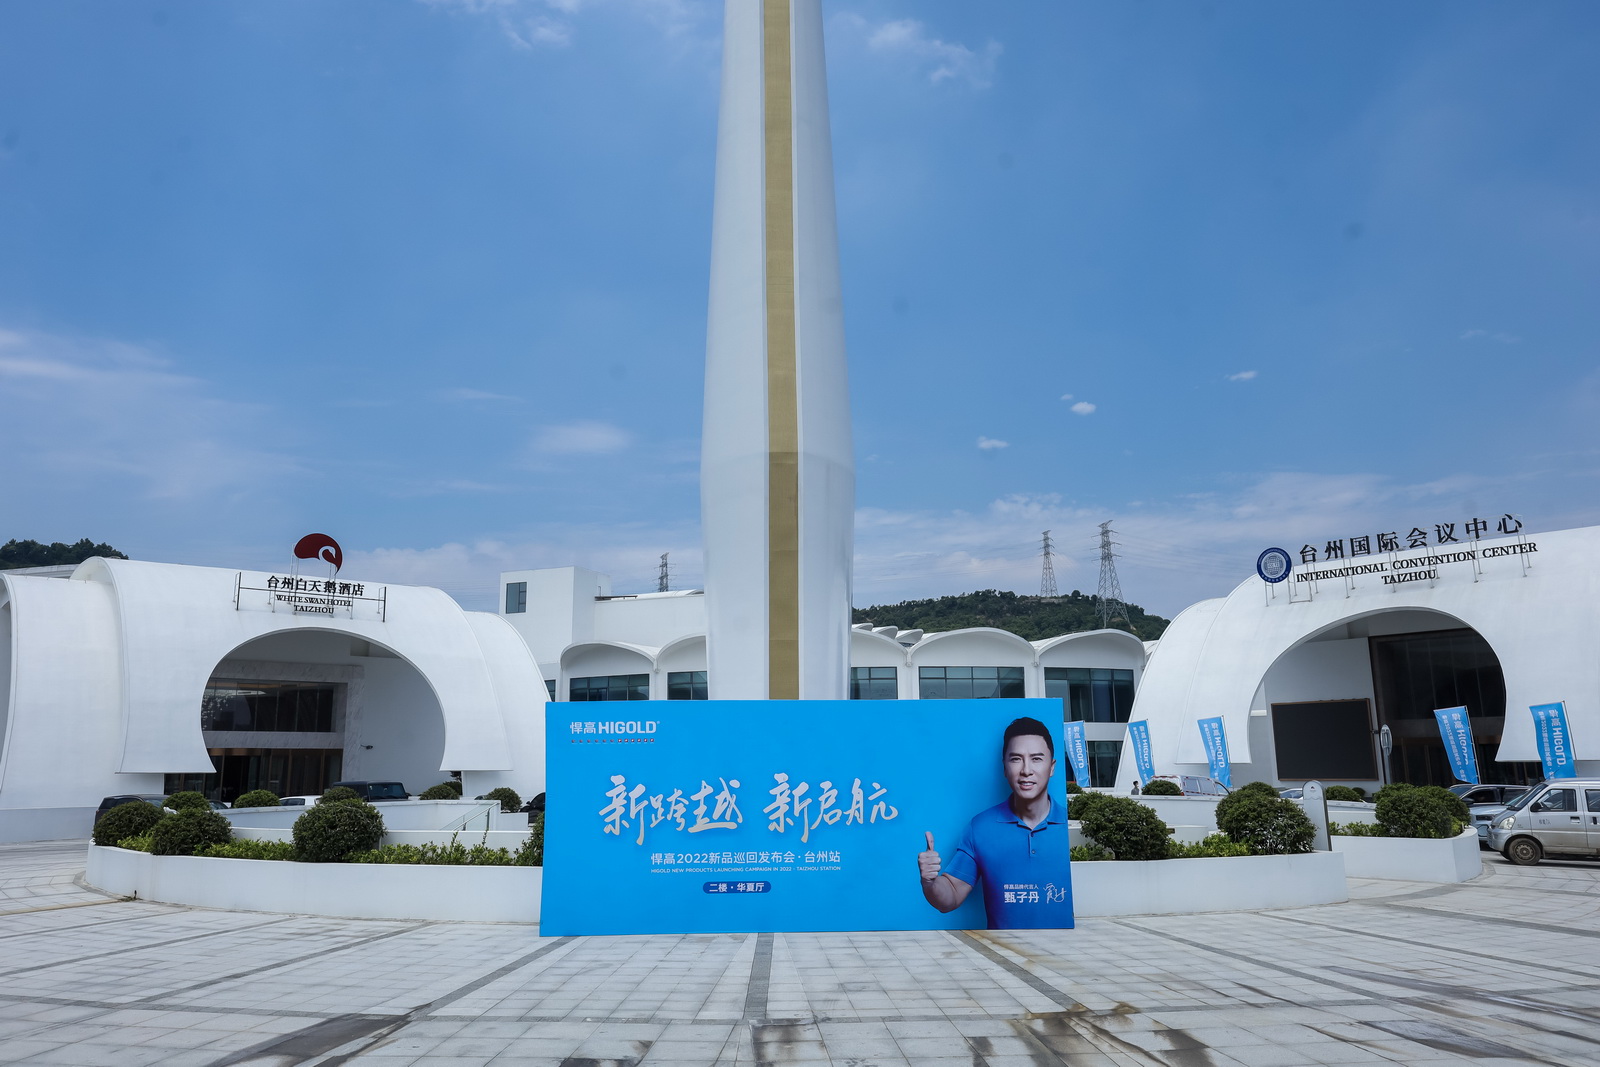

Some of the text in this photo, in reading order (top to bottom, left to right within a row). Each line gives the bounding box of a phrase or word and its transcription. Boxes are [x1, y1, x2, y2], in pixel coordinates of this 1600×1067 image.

[1299, 513, 1523, 564] 台州国际会议中心
[1296, 562, 1387, 583] INTERNATIONAL
[1392, 550, 1476, 570] CONVENTION
[1482, 542, 1538, 558] CENTER
[267, 575, 365, 596] 台州白天鹅酒店
[1381, 569, 1437, 585] TAIZHOU
[275, 594, 352, 607] WHITE SWAN HOTEL
[294, 604, 335, 614] TAIZHOU
[599, 772, 898, 846] 新跨越 新启航
[1004, 891, 1039, 903] 甄子丹
